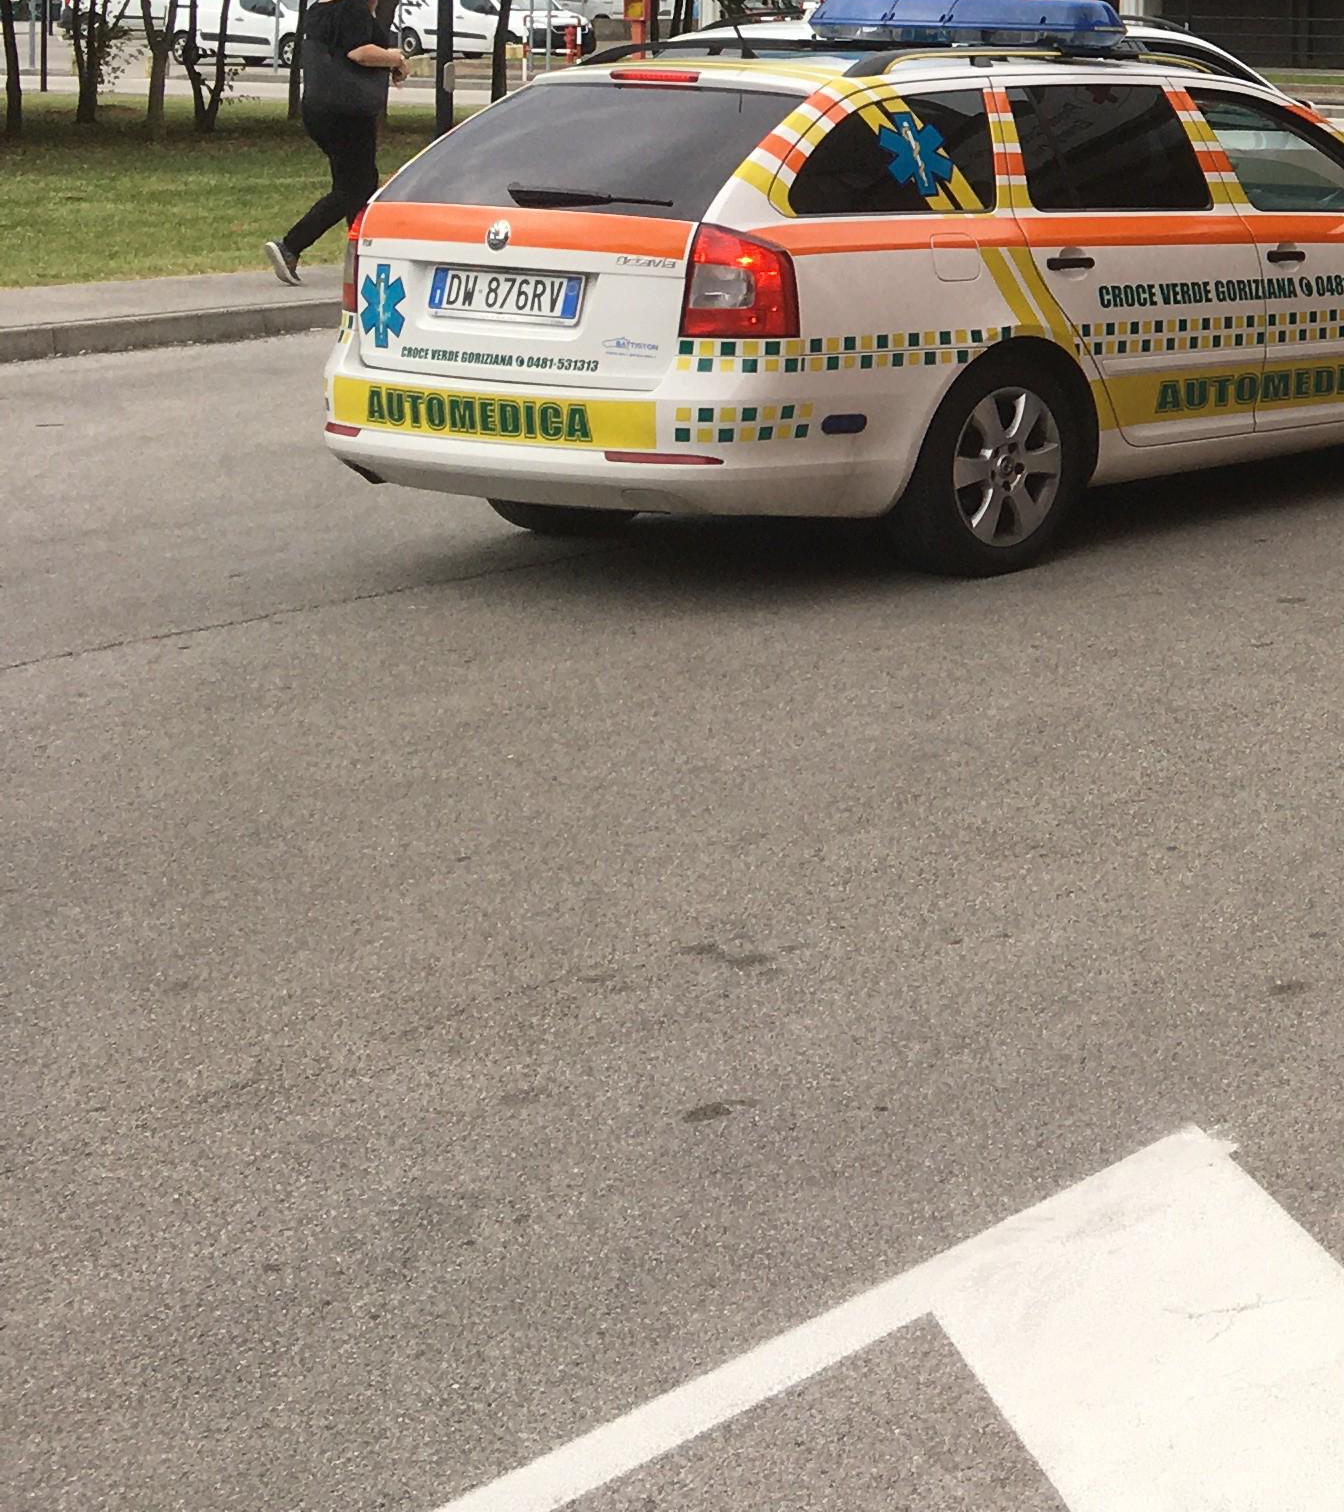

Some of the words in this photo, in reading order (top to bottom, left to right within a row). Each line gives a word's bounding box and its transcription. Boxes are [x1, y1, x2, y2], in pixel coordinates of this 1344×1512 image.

[446, 273, 479, 307] DW
[485, 276, 564, 314] 876RV
[1098, 283, 1158, 308] CROCE
[1159, 280, 1213, 305] VERDE
[1215, 277, 1298, 302] GORIZIANA
[401, 346, 429, 360] CROCE
[430, 348, 459, 363] VERDE
[460, 350, 514, 368] GORIZIANA
[366, 385, 593, 443] AUTOMEDICA
